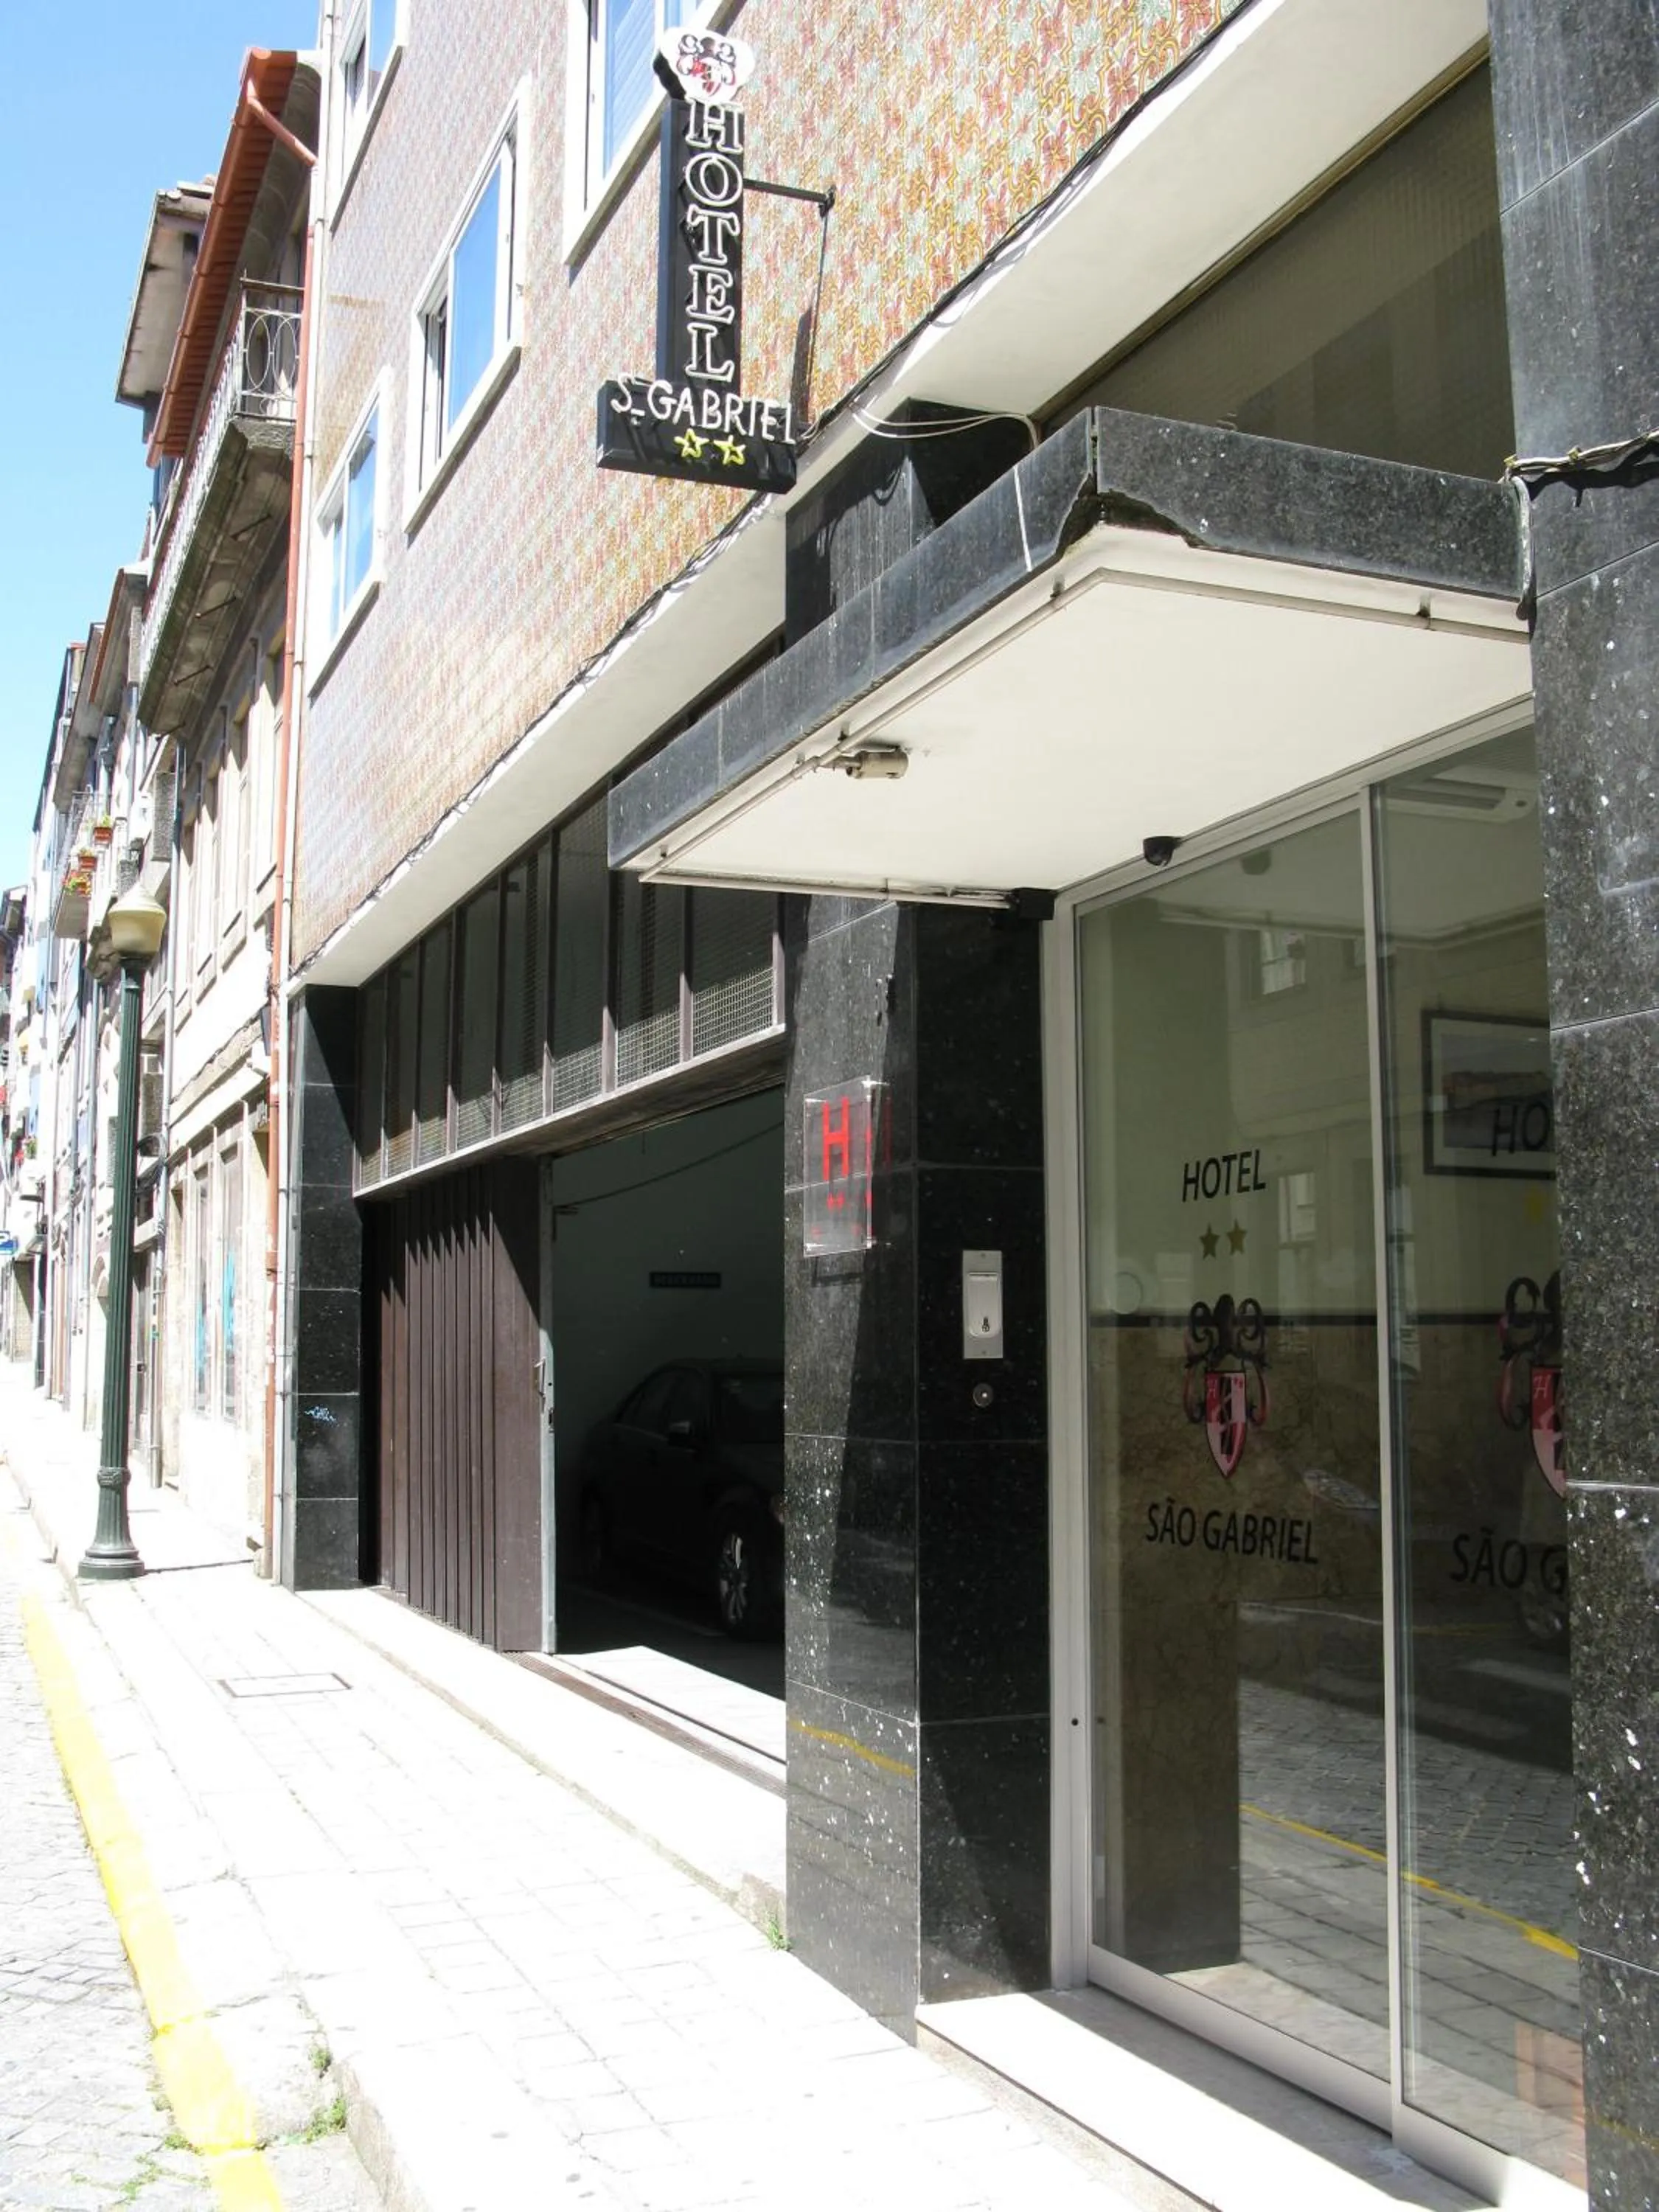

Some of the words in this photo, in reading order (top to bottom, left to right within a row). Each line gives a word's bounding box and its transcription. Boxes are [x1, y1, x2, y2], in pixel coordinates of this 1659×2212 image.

[685, 99, 744, 383] HOTEL
[647, 380, 796, 445] GABRIEL
[821, 1096, 850, 1181] H
[1182, 1149, 1267, 1203] HOTEL
[1146, 1496, 1197, 1547] SÃO
[1203, 1510, 1319, 1565] GABRIEL
[1450, 1526, 1528, 1589] SÃO
